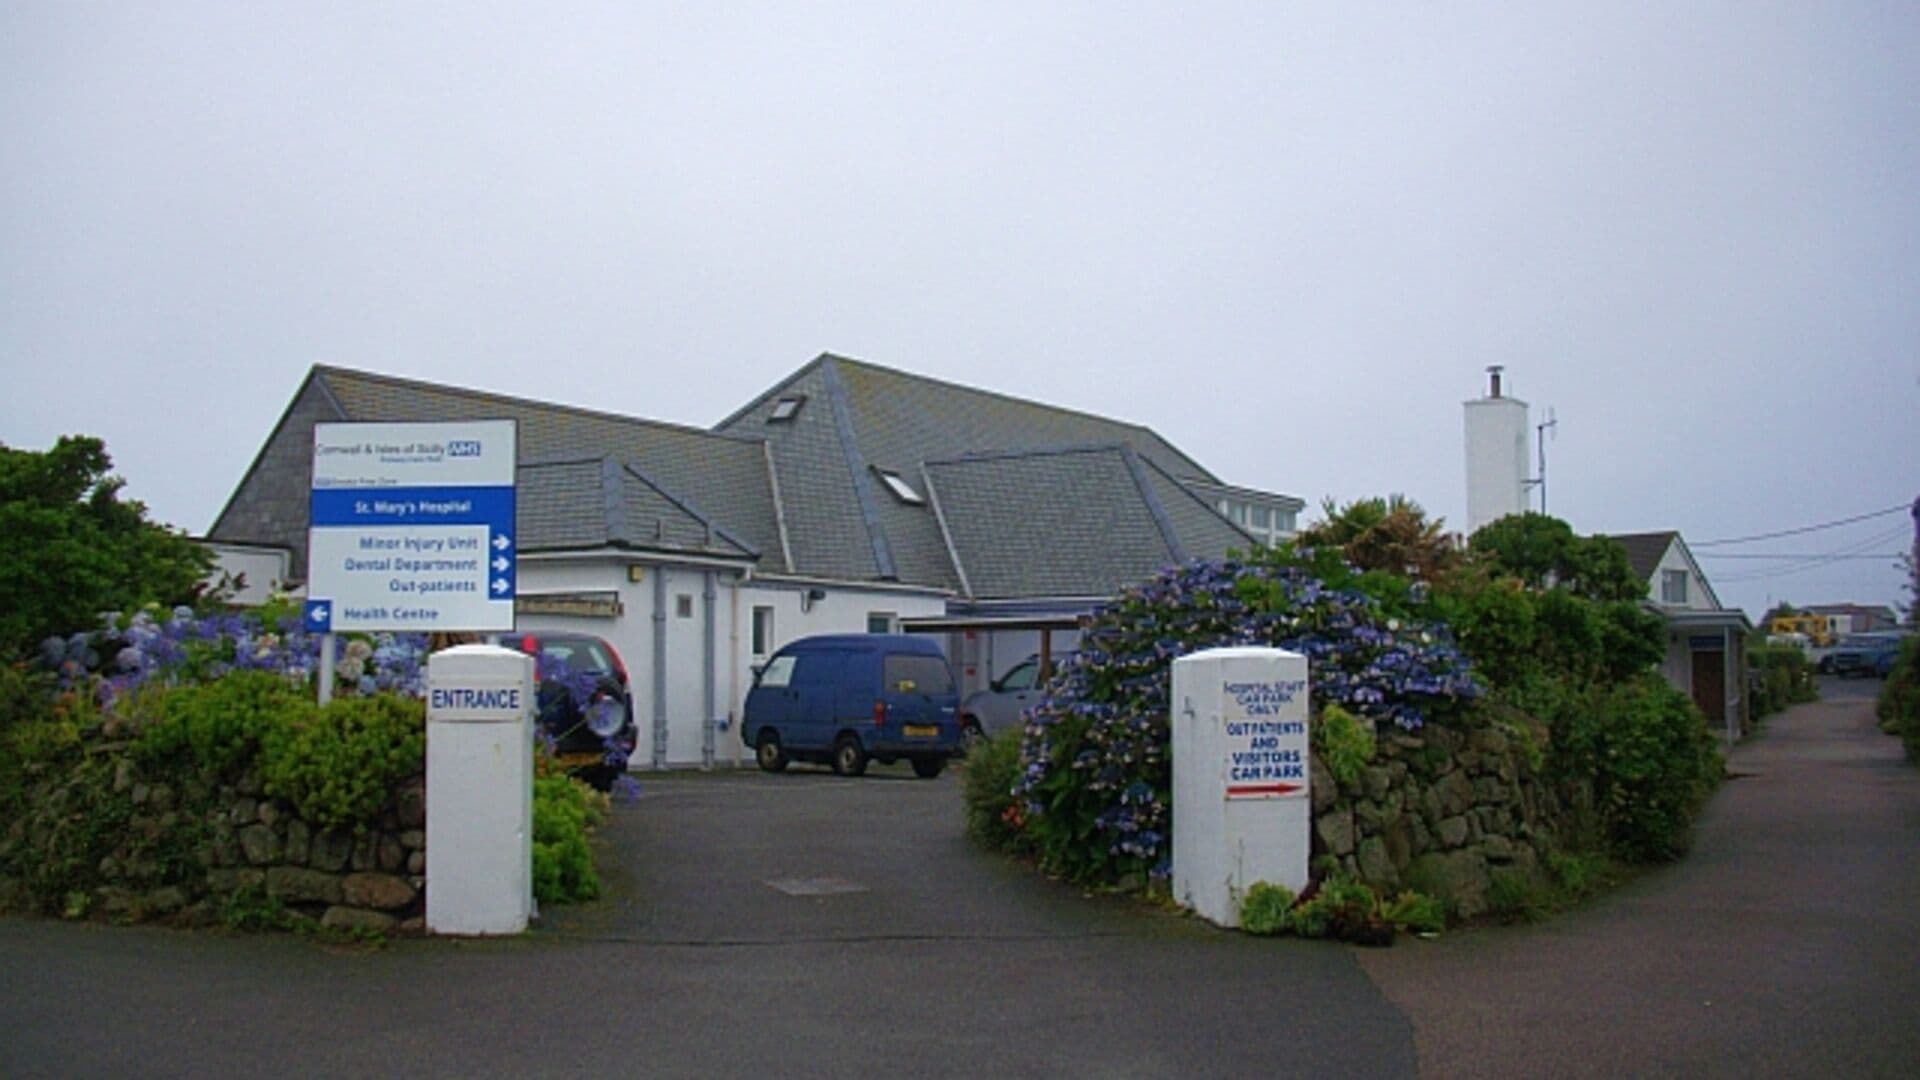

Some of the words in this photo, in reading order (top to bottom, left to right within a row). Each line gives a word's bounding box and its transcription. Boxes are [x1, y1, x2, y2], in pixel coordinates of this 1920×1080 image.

[403, 443, 415, 454] of
[449, 442, 480, 456] NHS
[354, 501, 370, 514] St.
[374, 501, 415, 516] Mary's
[419, 500, 471, 515] Hospital
[359, 537, 400, 550] Minor
[404, 536, 444, 552] Injury
[448, 536, 479, 549] Unit
[345, 558, 390, 571] Dental
[394, 557, 478, 573] Department
[389, 579, 477, 594] Out-patients
[344, 606, 388, 619] Health
[392, 606, 439, 619] Centre
[432, 689, 520, 708] ENTRANCE
[1251, 737, 1279, 749] AND
[1232, 750, 1301, 765] VISITORS
[1232, 767, 1261, 780] CAR
[1263, 765, 1304, 779] PARK
